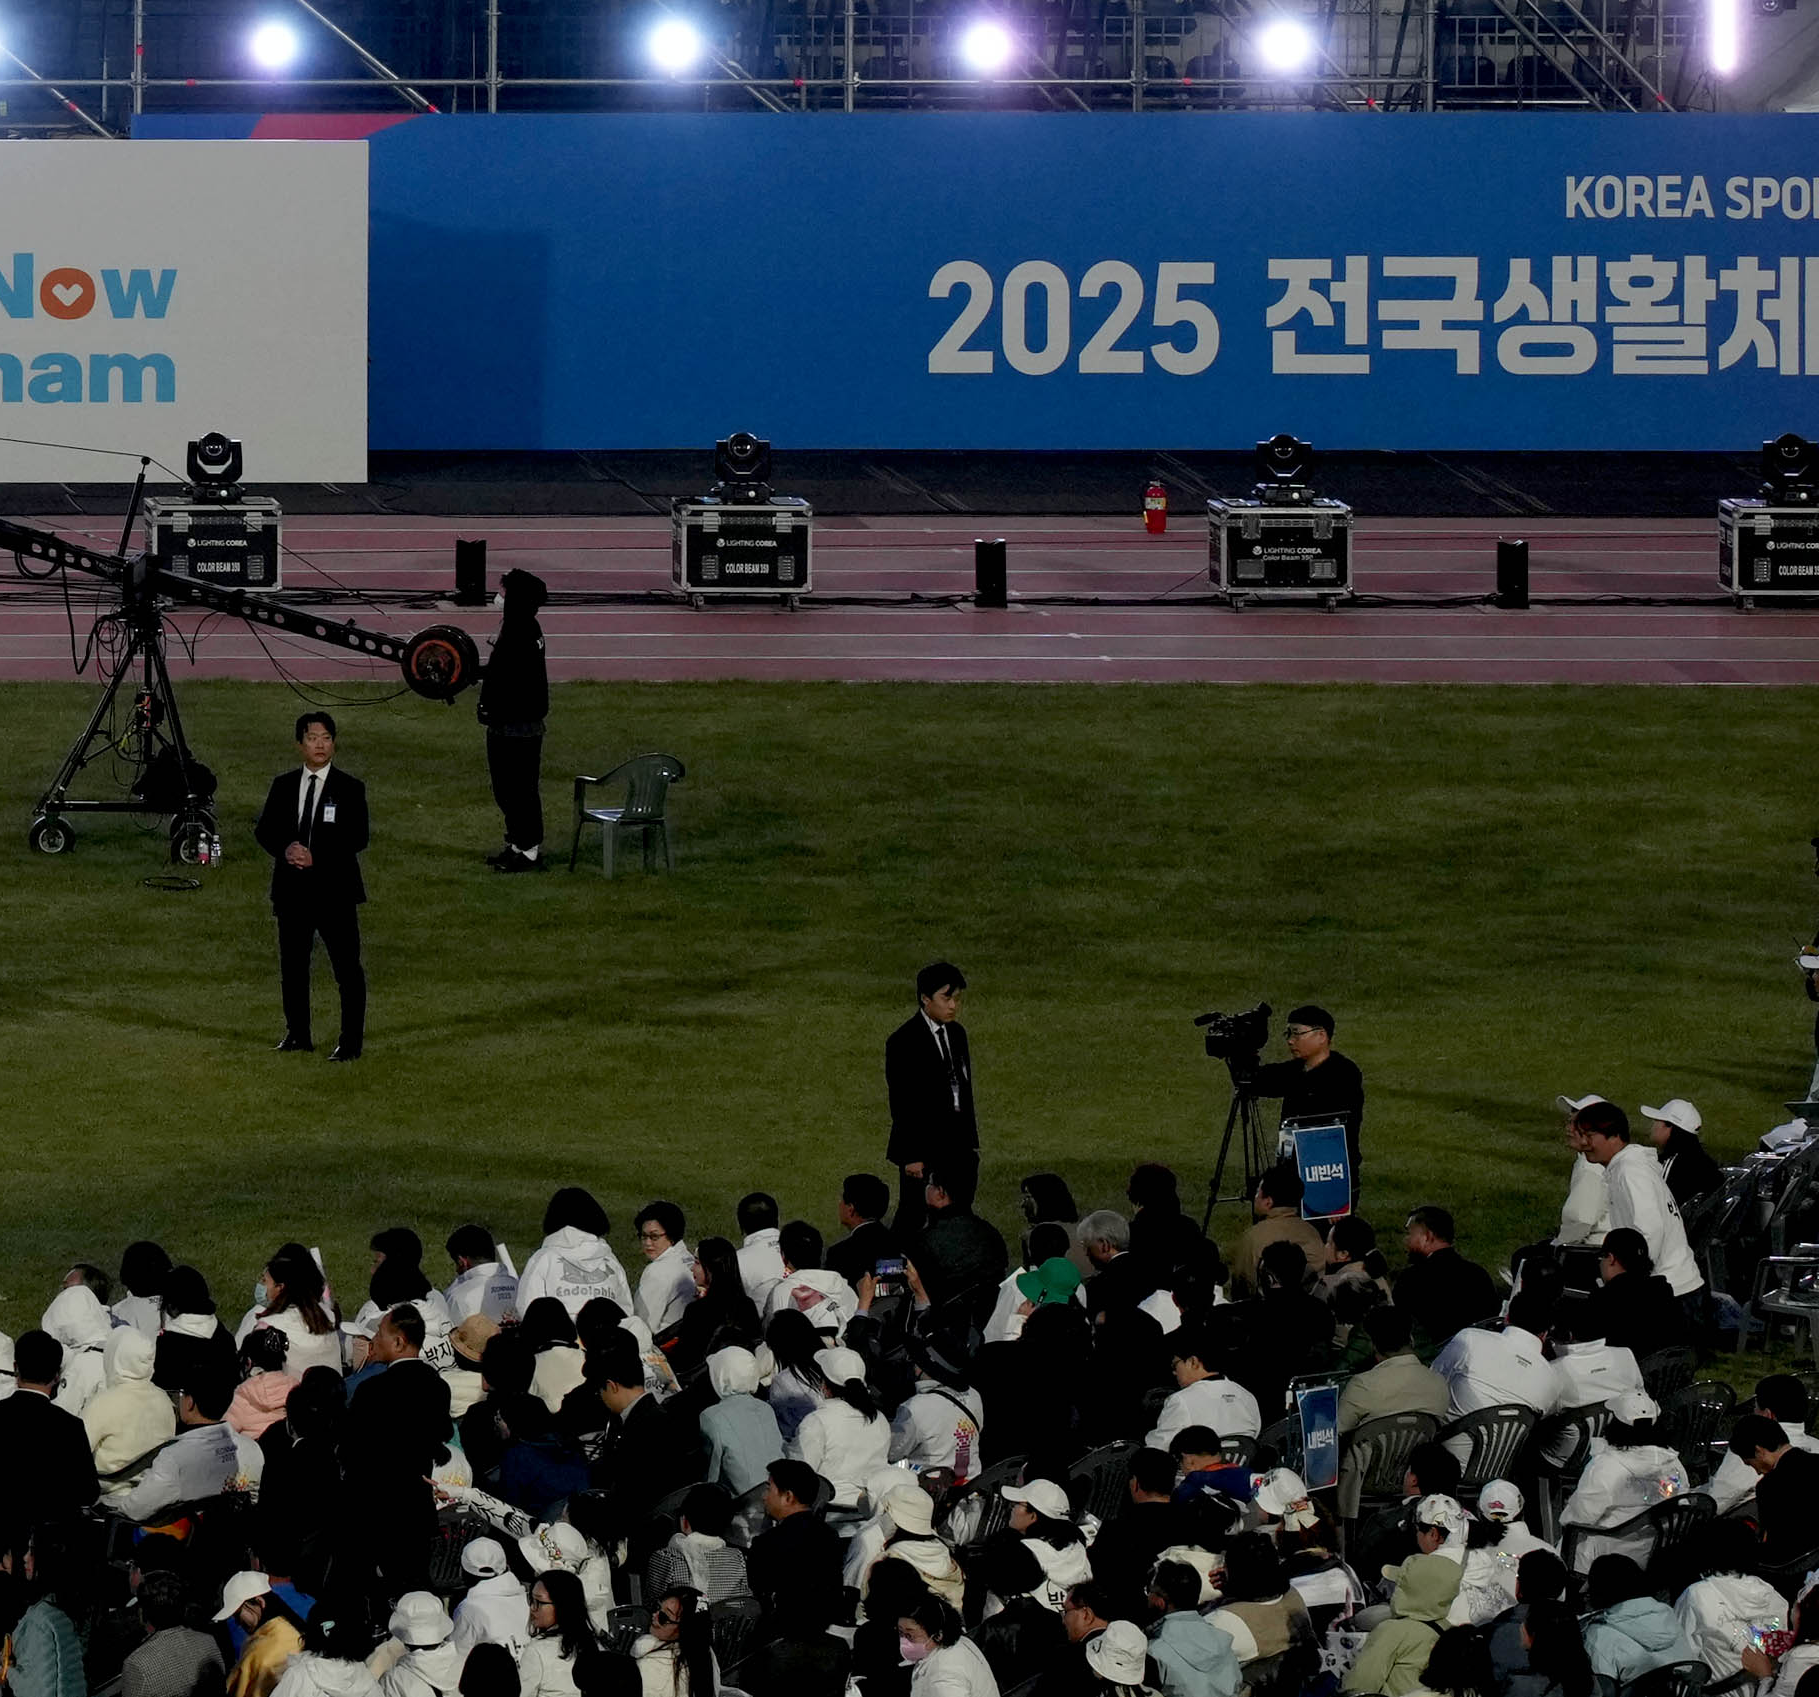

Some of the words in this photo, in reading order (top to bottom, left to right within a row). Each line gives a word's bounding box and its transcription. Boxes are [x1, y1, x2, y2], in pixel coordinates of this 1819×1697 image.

[1565, 175, 1715, 219] KOREA
[1725, 176, 1819, 220] SPO
[927, 259, 1220, 376] 2025
[1305, 1163, 1345, 1183] 내빈석
